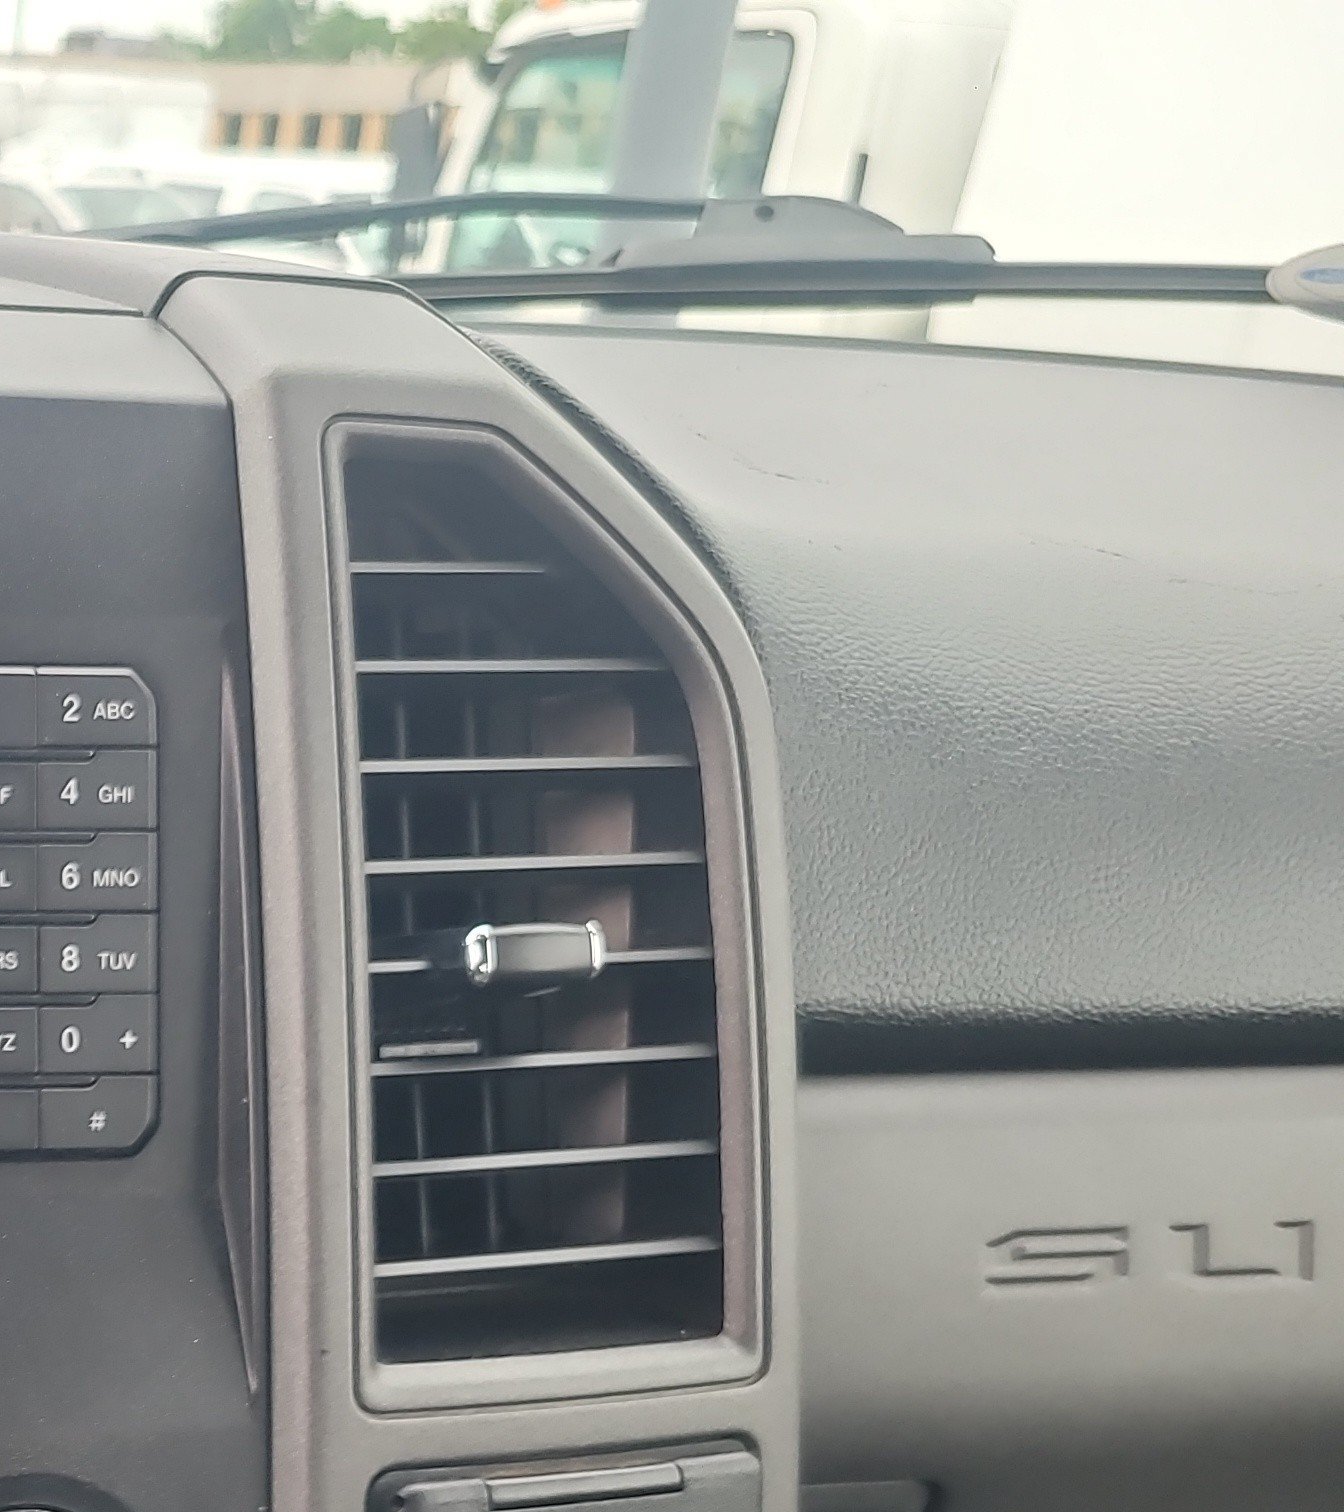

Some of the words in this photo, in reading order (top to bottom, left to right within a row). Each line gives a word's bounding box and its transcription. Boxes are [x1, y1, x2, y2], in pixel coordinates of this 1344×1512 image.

[62, 693, 82, 723] 2
[92, 700, 138, 722] ABC
[60, 777, 81, 805] 4
[97, 784, 136, 805] GHI
[61, 861, 82, 890] 6
[92, 868, 141, 889] MNO
[60, 943, 81, 972] 8
[96, 951, 138, 971] TUV
[60, 1026, 81, 1053] 0
